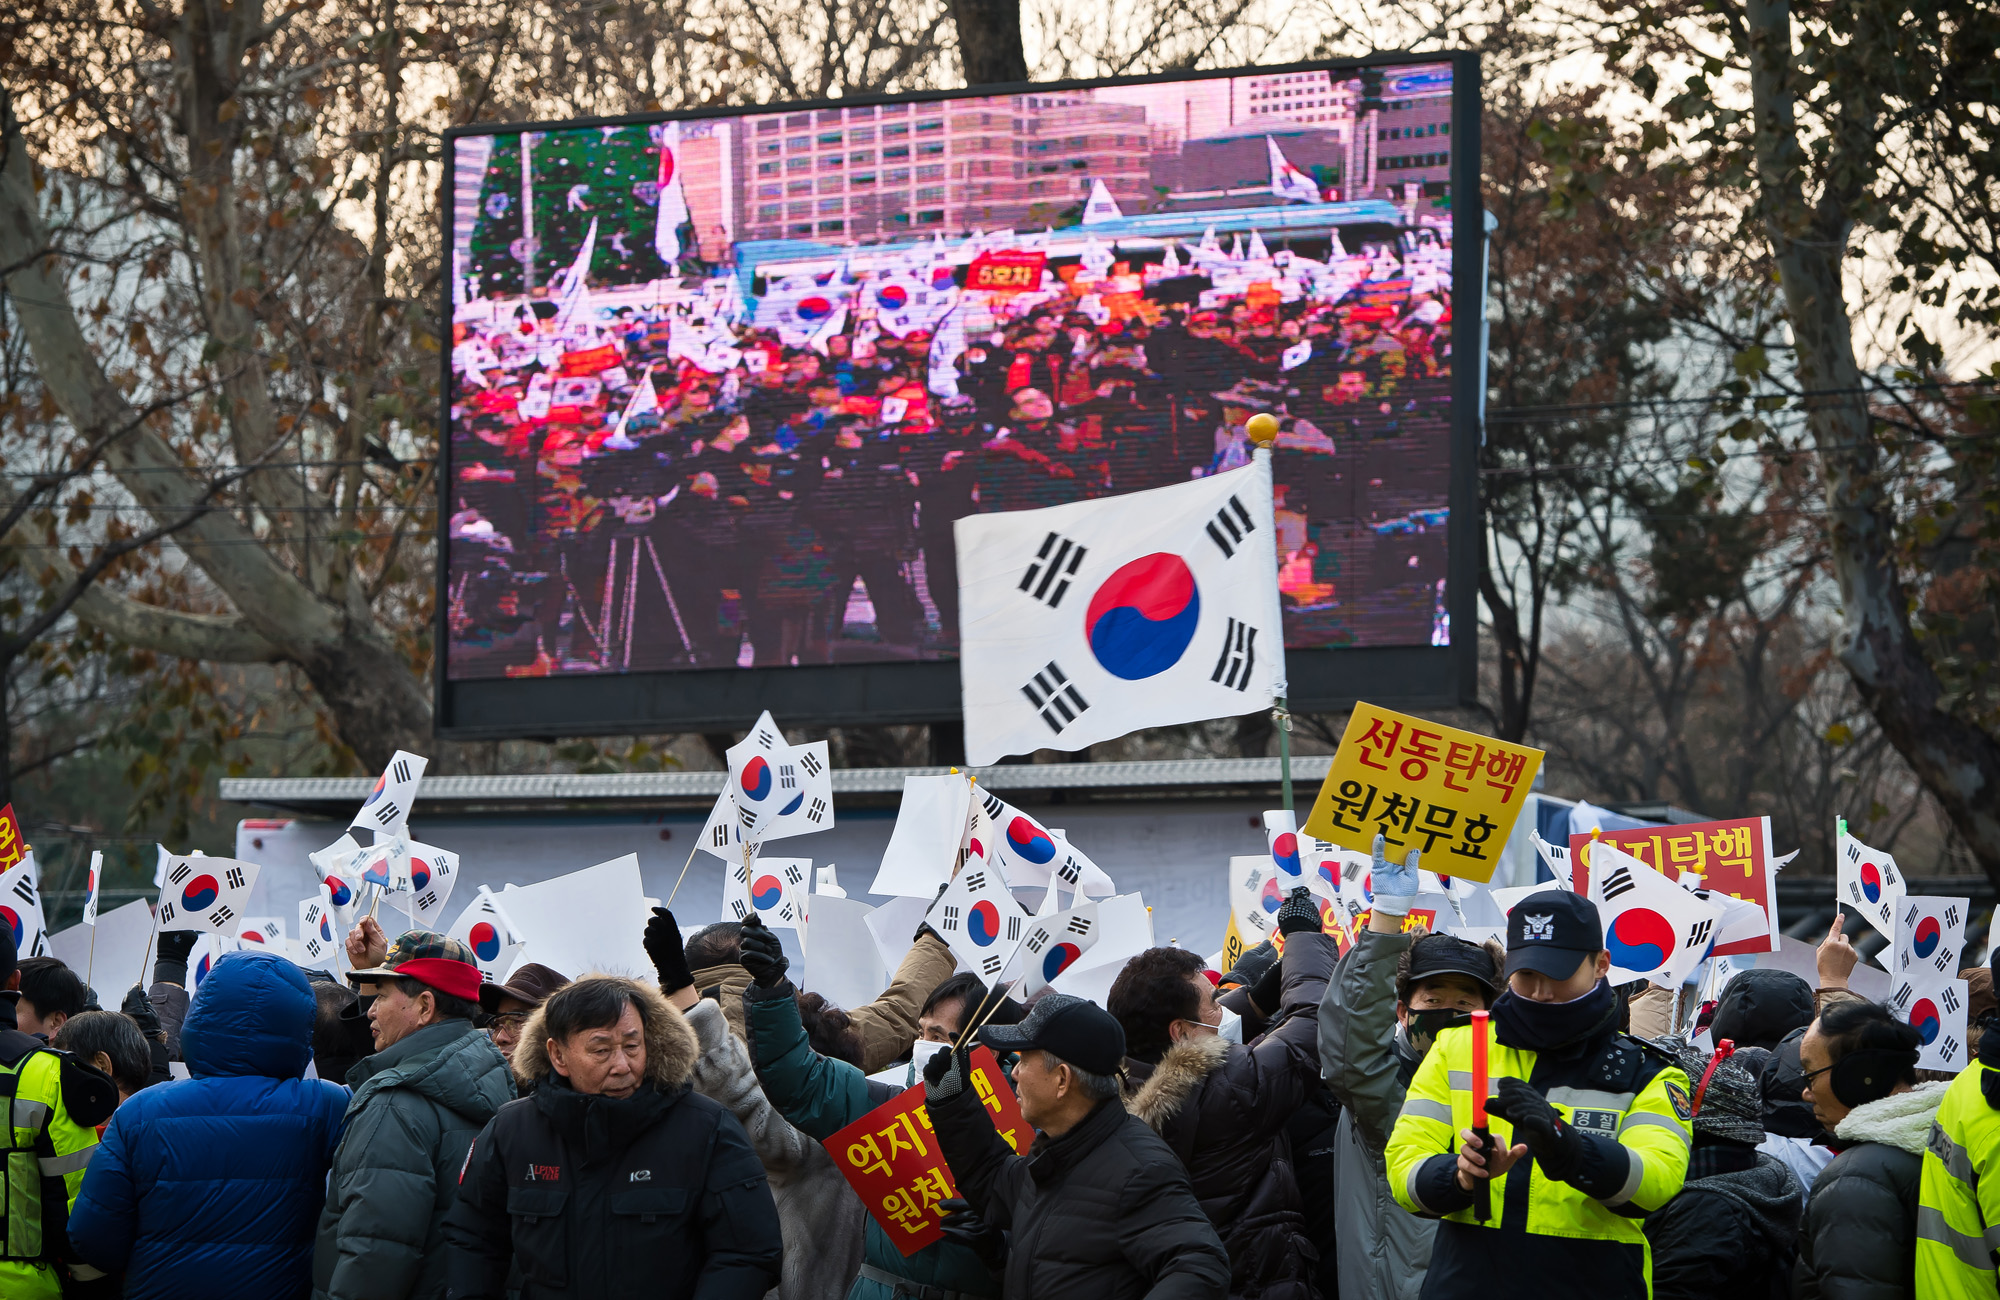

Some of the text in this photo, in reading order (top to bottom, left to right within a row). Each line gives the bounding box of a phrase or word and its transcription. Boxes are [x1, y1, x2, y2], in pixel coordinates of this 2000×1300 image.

[1354, 717, 1528, 804] 선동탄핵
[1331, 780, 1498, 860] 원천무효
[1576, 1112, 1615, 1130] 경찰
[524, 1163, 561, 1181] ALPINE
[628, 1169, 652, 1183] K2
